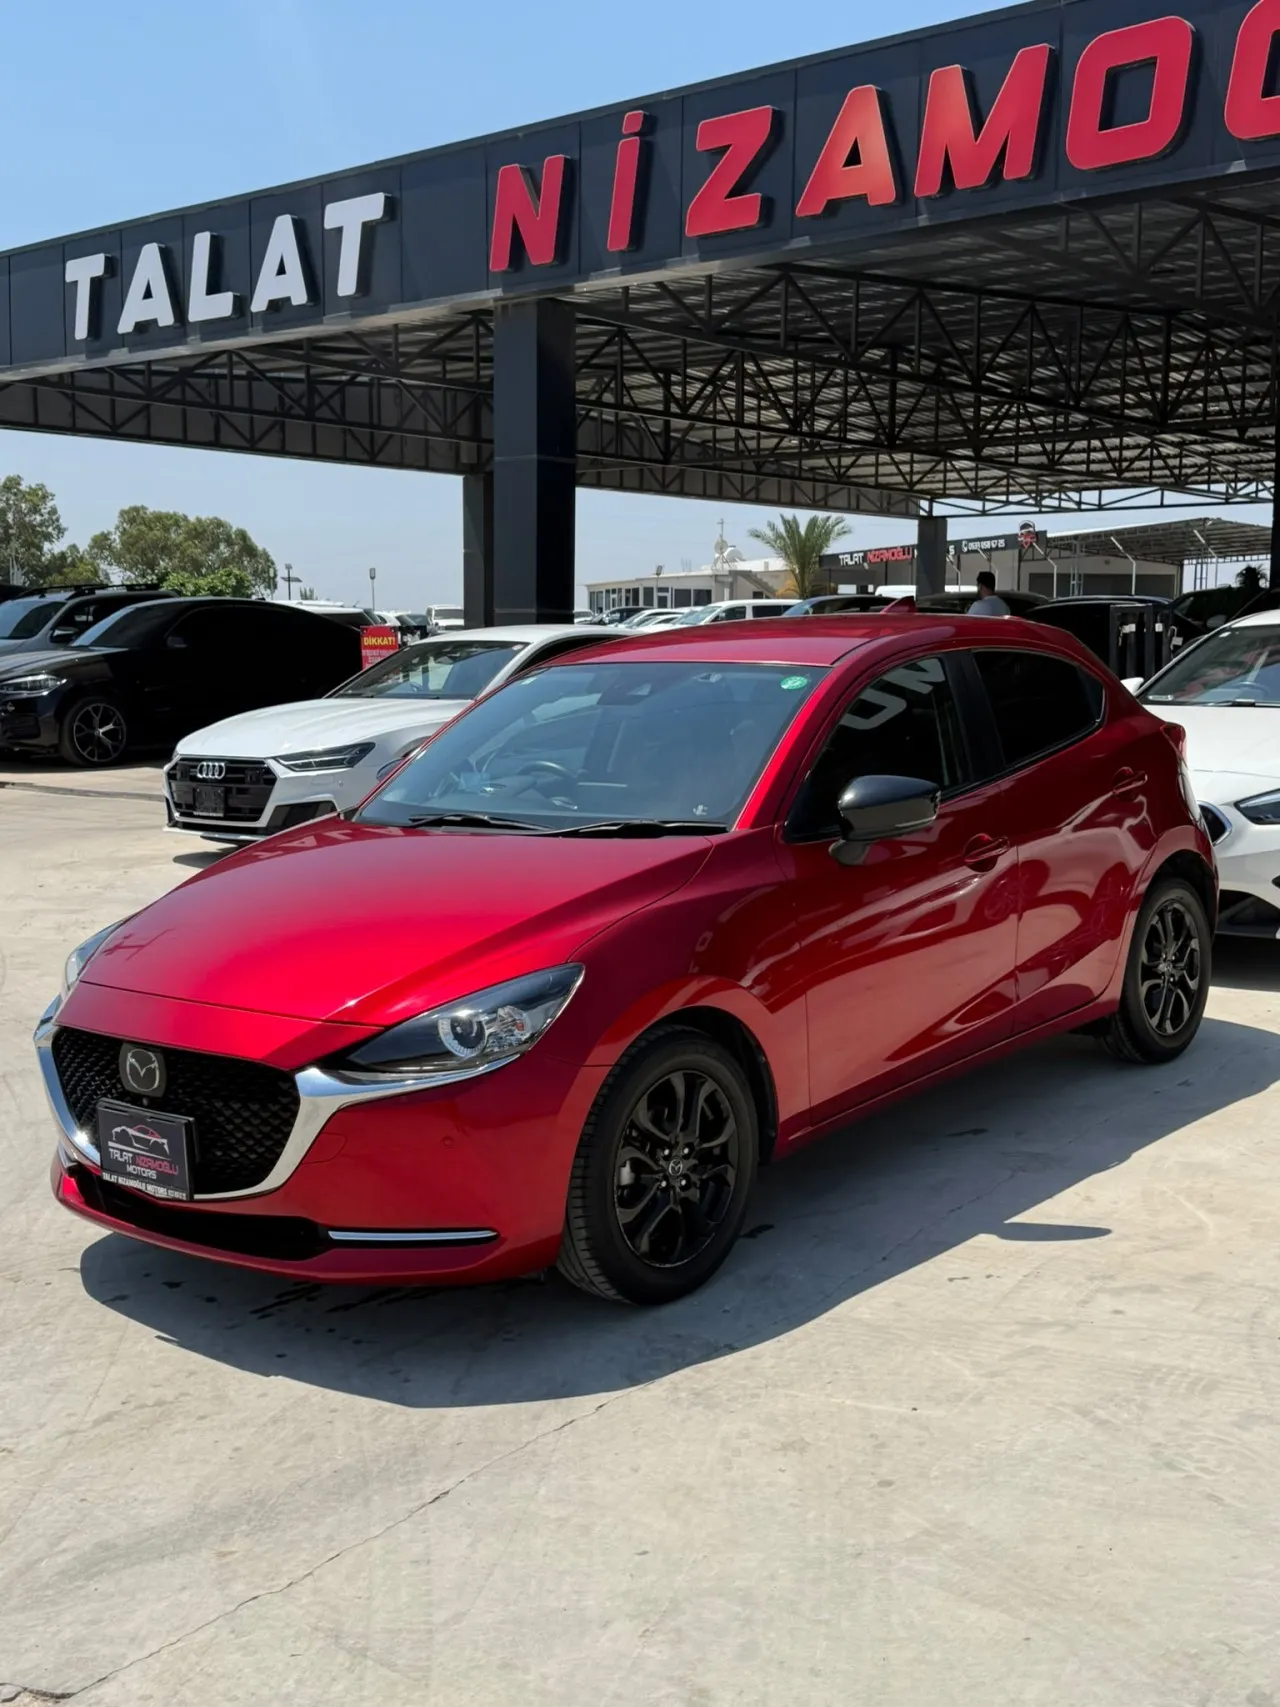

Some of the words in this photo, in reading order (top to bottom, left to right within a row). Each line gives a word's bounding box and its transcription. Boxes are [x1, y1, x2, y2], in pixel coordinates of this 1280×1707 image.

[65, 192, 388, 341] TALAT
[839, 552, 864, 566] TALAT
[109, 1148, 133, 1163] TALAT
[127, 1164, 157, 1179] MOTORS
